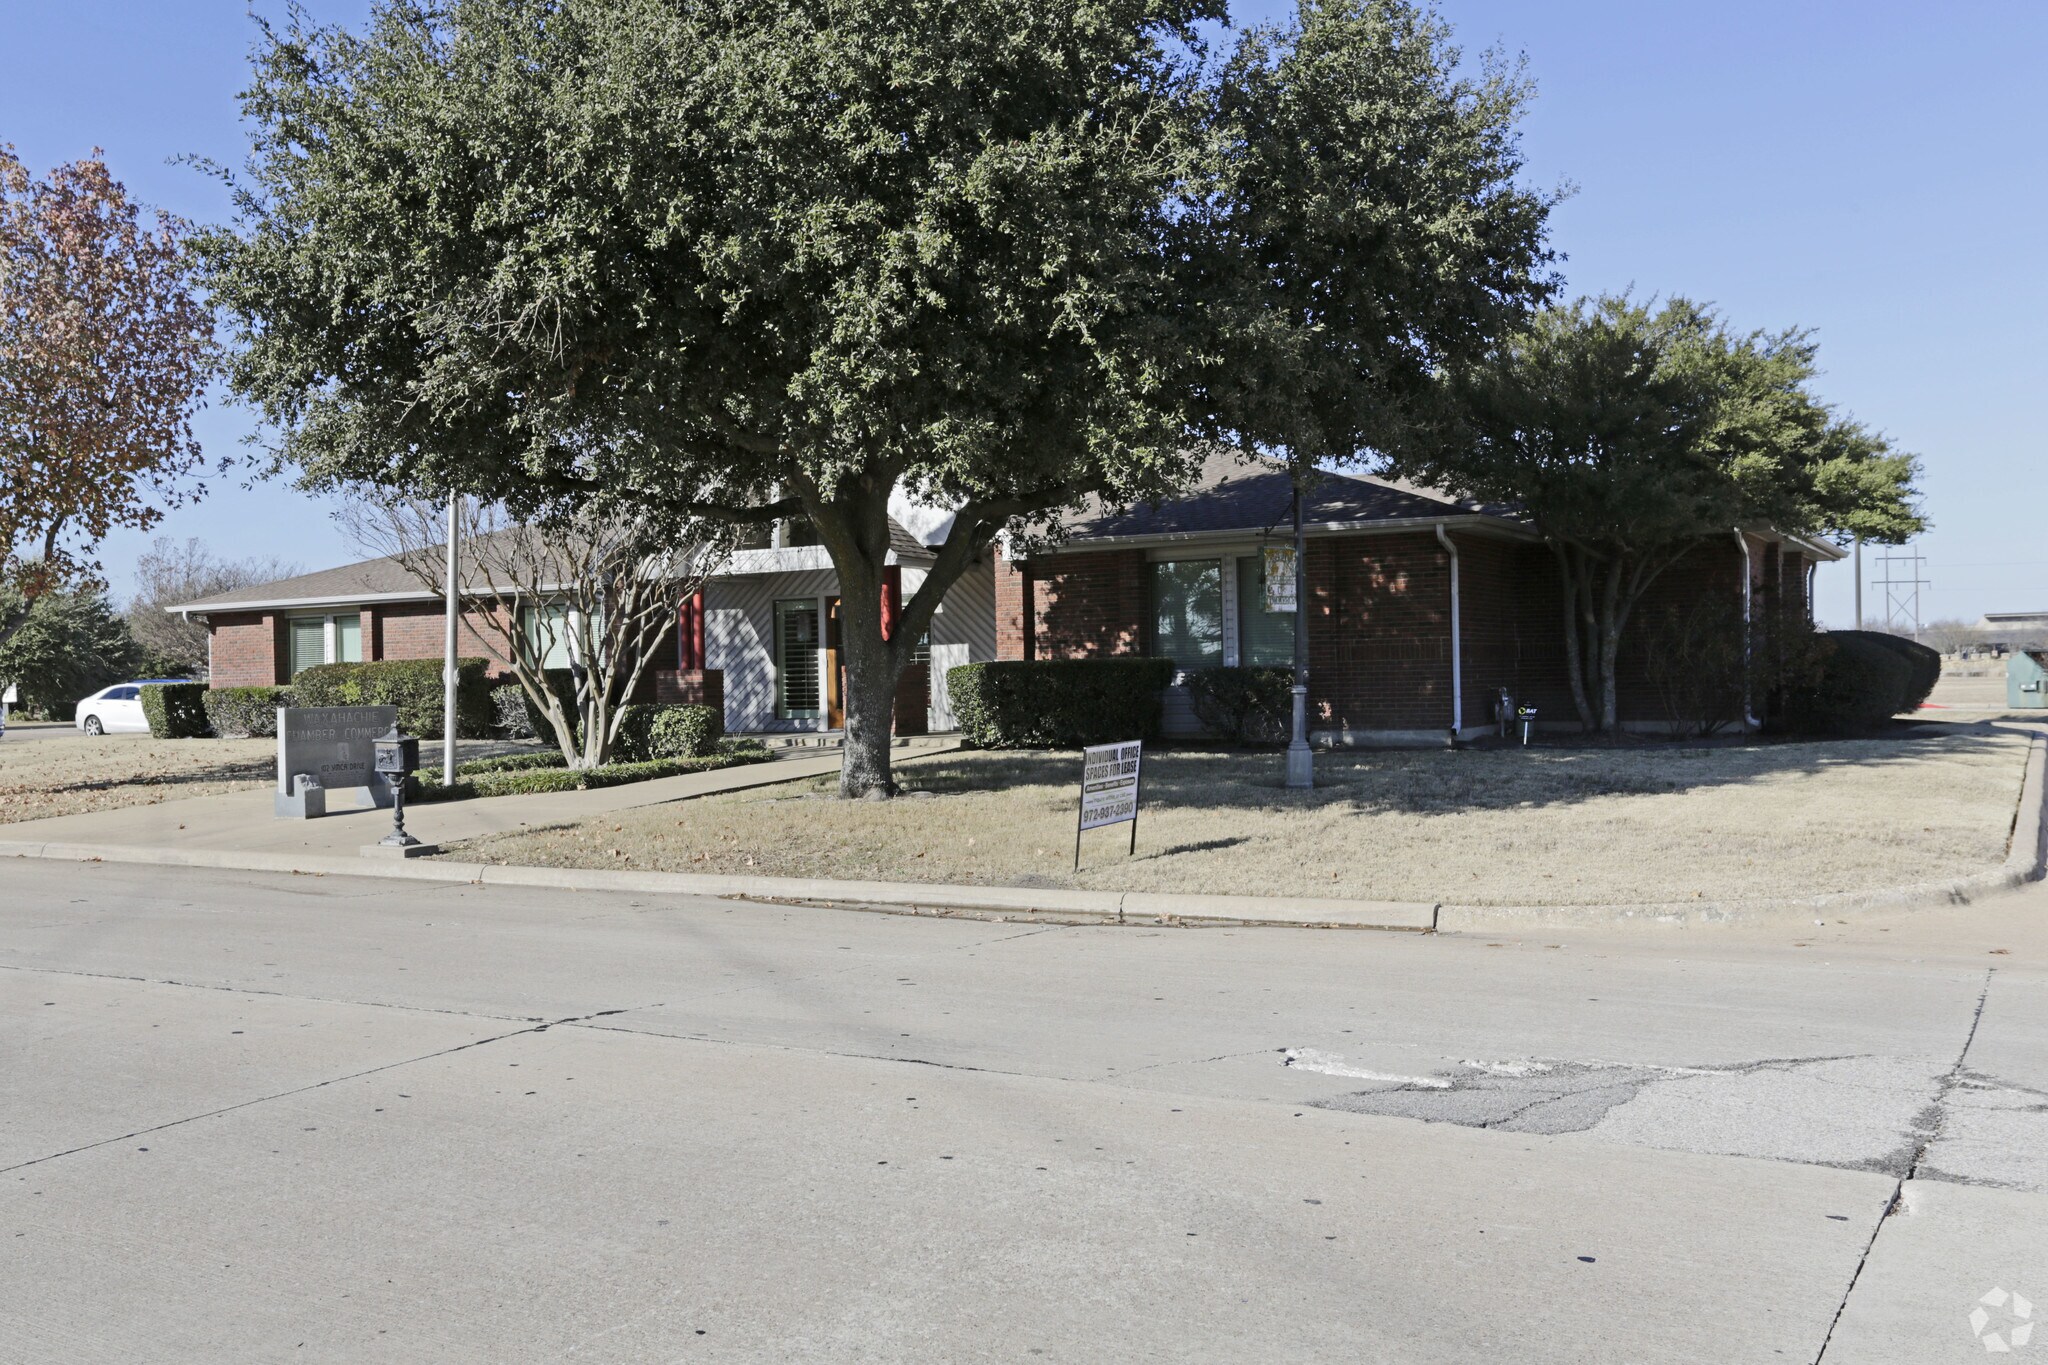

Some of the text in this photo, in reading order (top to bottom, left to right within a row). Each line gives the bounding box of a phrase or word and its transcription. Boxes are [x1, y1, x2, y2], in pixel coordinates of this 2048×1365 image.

[304, 711, 379, 723] WAXAHACHIE
[287, 729, 336, 741] CHAMBER
[1121, 745, 1139, 759] OFFICE
[331, 762, 348, 772] YMCA
[349, 761, 366, 771] DRIVE
[1085, 760, 1137, 780] SPACES FOR LEASE
[1084, 801, 1133, 822] 972-937-2390
